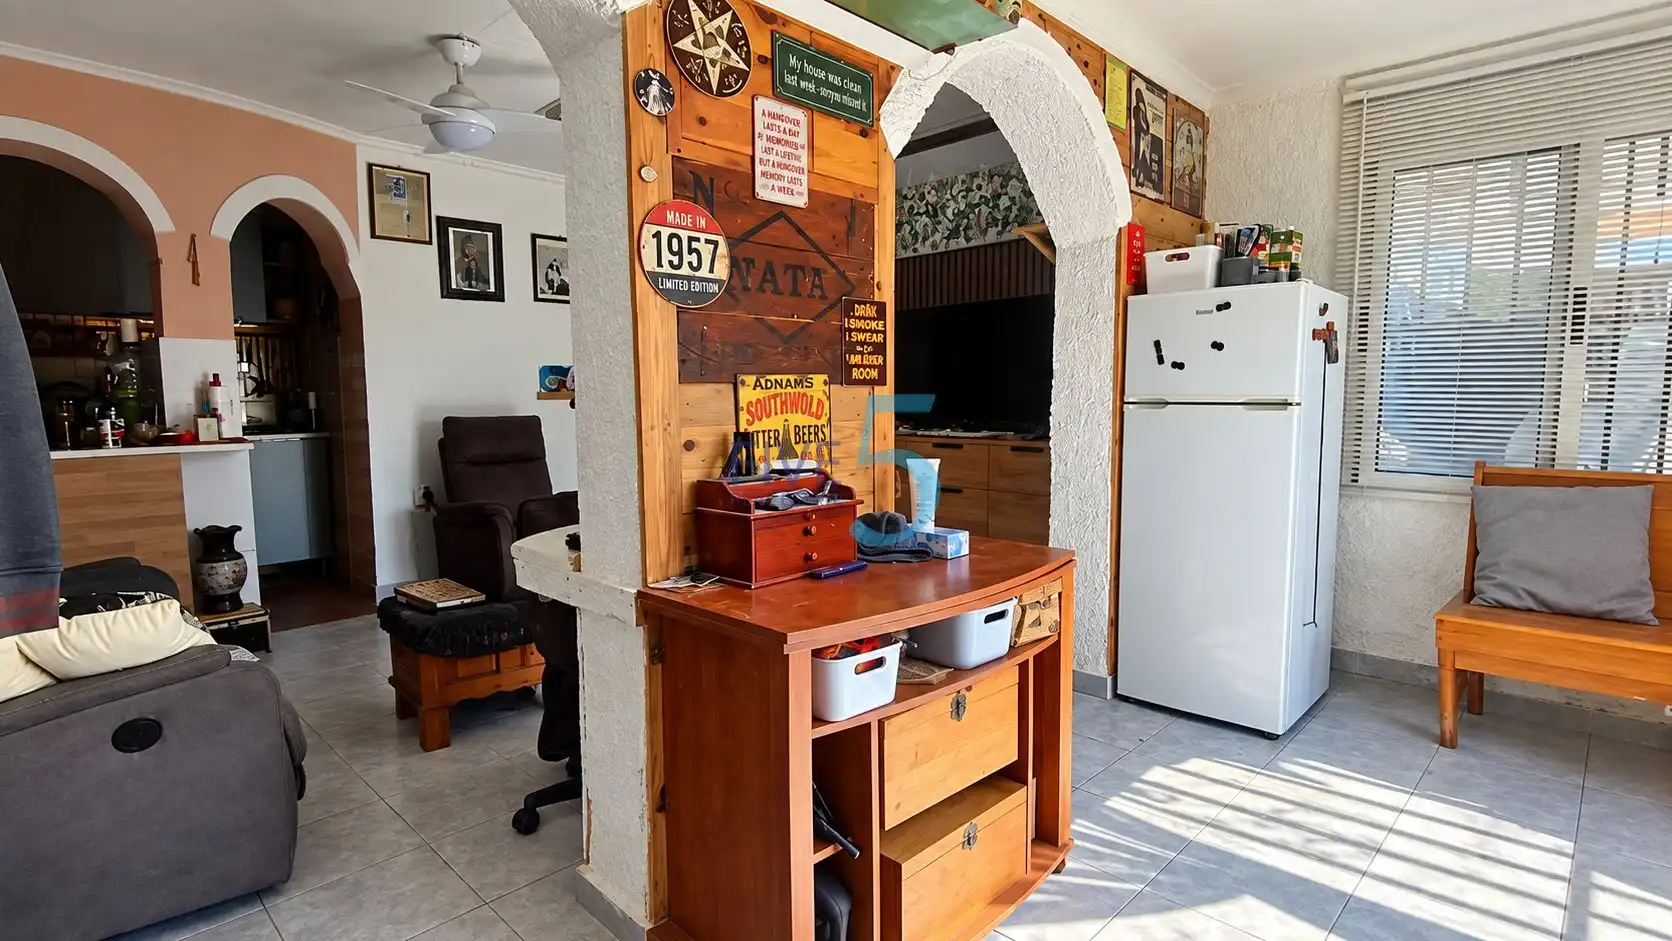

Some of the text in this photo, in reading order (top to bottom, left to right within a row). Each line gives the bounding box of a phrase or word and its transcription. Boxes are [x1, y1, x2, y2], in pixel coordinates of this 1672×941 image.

[784, 69, 798, 87] last
[789, 53, 862, 94] My house was clean
[761, 109, 766, 118] A
[666, 210, 706, 229] MADE IN
[651, 229, 719, 274] 1957
[658, 277, 719, 294] LIMITED EDITION
[848, 318, 885, 331] SMOKE
[850, 331, 884, 343] SWEAR
[852, 367, 878, 380] ROOM
[752, 376, 814, 391] ADNAMS
[745, 391, 825, 427] SOUTHWOLD
[751, 428, 781, 449] ITTER
